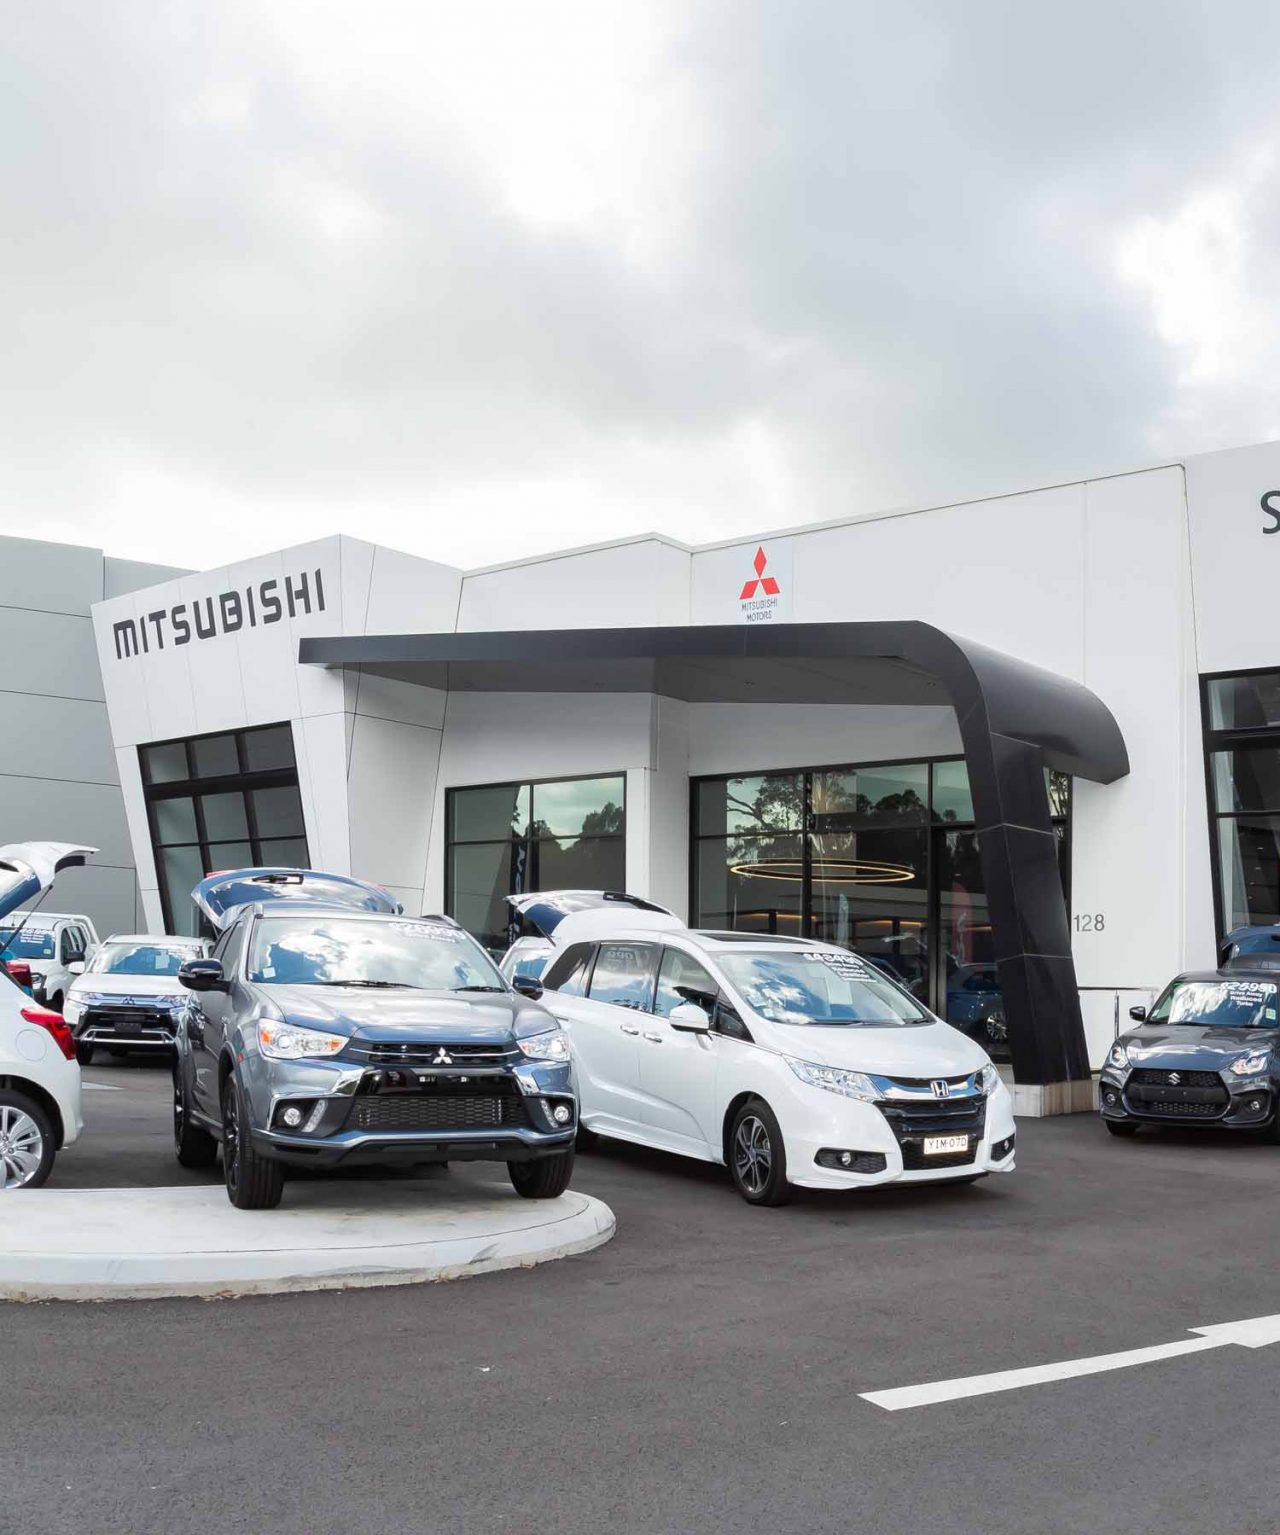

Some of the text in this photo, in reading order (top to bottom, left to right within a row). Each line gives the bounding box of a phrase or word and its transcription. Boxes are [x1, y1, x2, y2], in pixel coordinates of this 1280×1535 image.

[741, 597, 778, 611] MITSUBISHI
[113, 568, 325, 659] MITSUBISHI
[746, 610, 773, 621] MOTORS
[1073, 914, 1105, 932] 128
